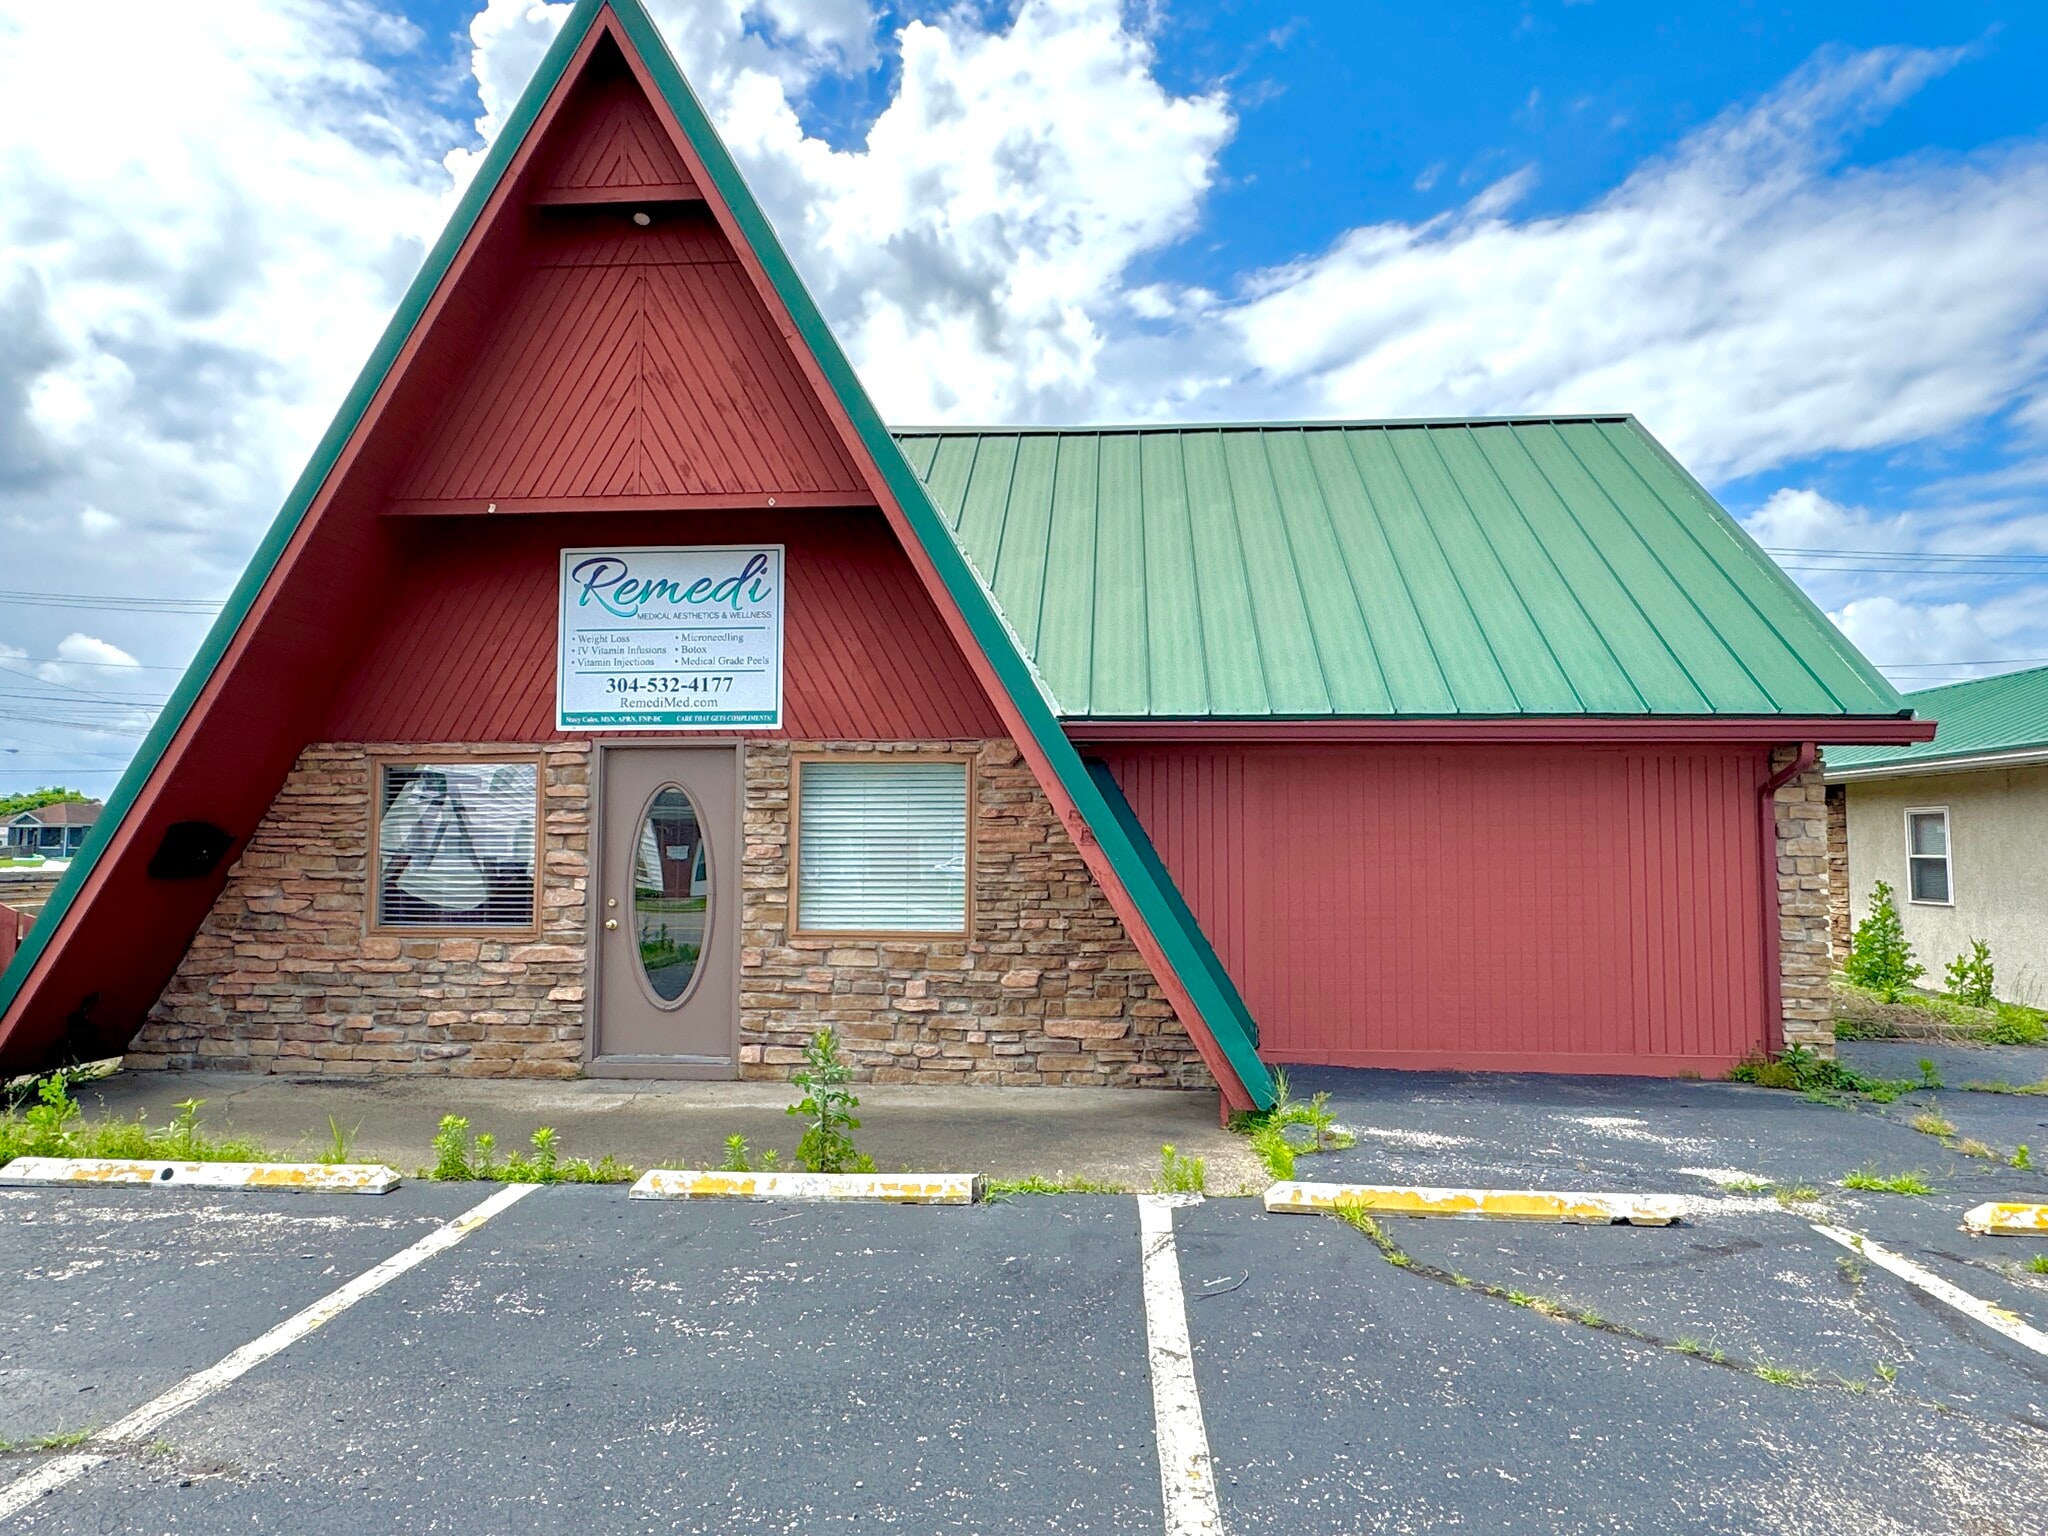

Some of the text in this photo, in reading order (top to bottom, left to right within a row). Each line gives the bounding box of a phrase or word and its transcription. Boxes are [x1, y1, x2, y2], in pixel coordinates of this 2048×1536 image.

[572, 553, 772, 617] Remedi
[637, 610, 772, 620] MEDICAL AESTHETICS & WELLNESS
[578, 634, 630, 645] Weight Loss
[681, 633, 744, 643] Microneedling
[577, 646, 667, 655] IV Vitamin Infusions
[681, 645, 707, 654] Botox
[577, 657, 655, 668] Vitamin Injections
[681, 655, 770, 665] Medical Grade Peels
[605, 677, 734, 694] 304-532-4177
[620, 697, 719, 709] RemediMed.com
